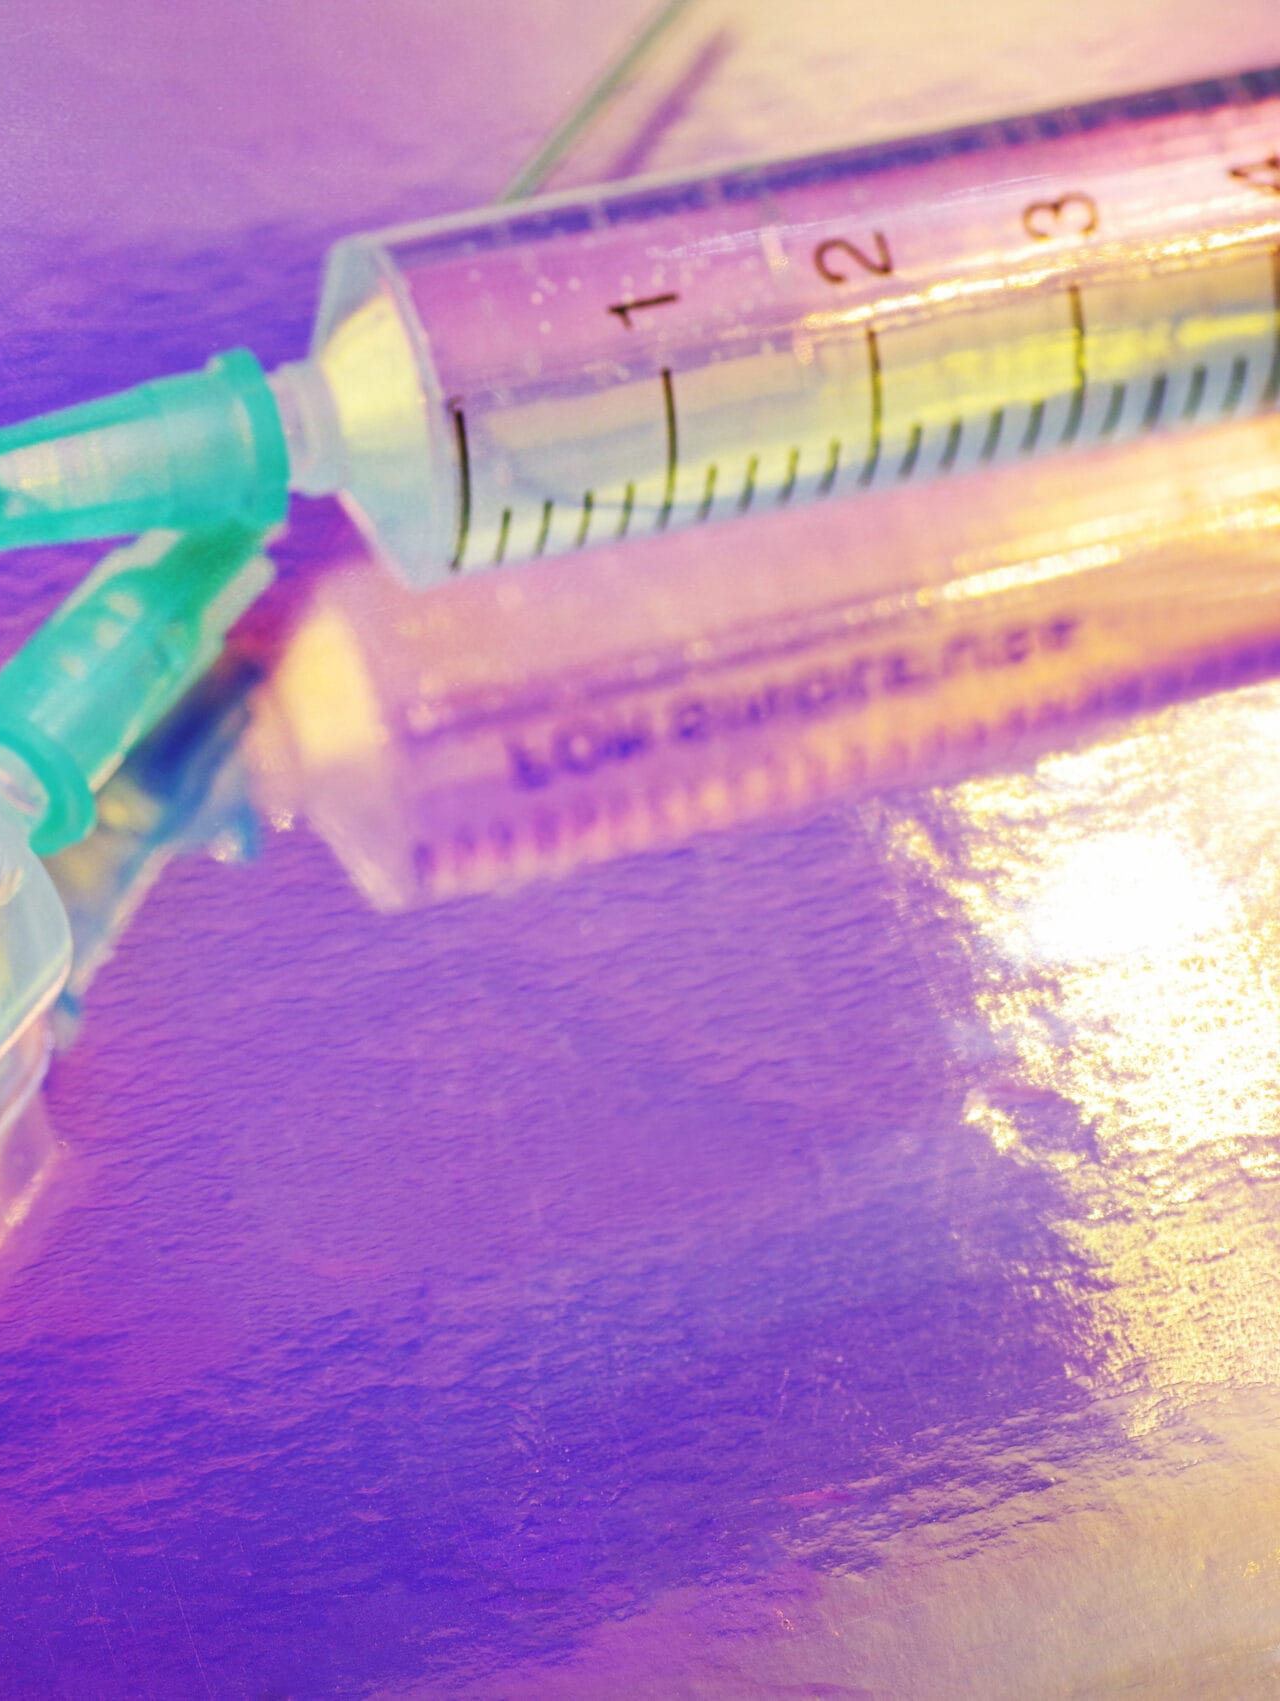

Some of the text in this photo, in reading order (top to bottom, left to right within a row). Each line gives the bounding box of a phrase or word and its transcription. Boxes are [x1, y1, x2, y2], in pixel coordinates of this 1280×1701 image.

[1022, 191, 1099, 242] 3
[813, 231, 894, 285] 2
[608, 292, 679, 329] 1
